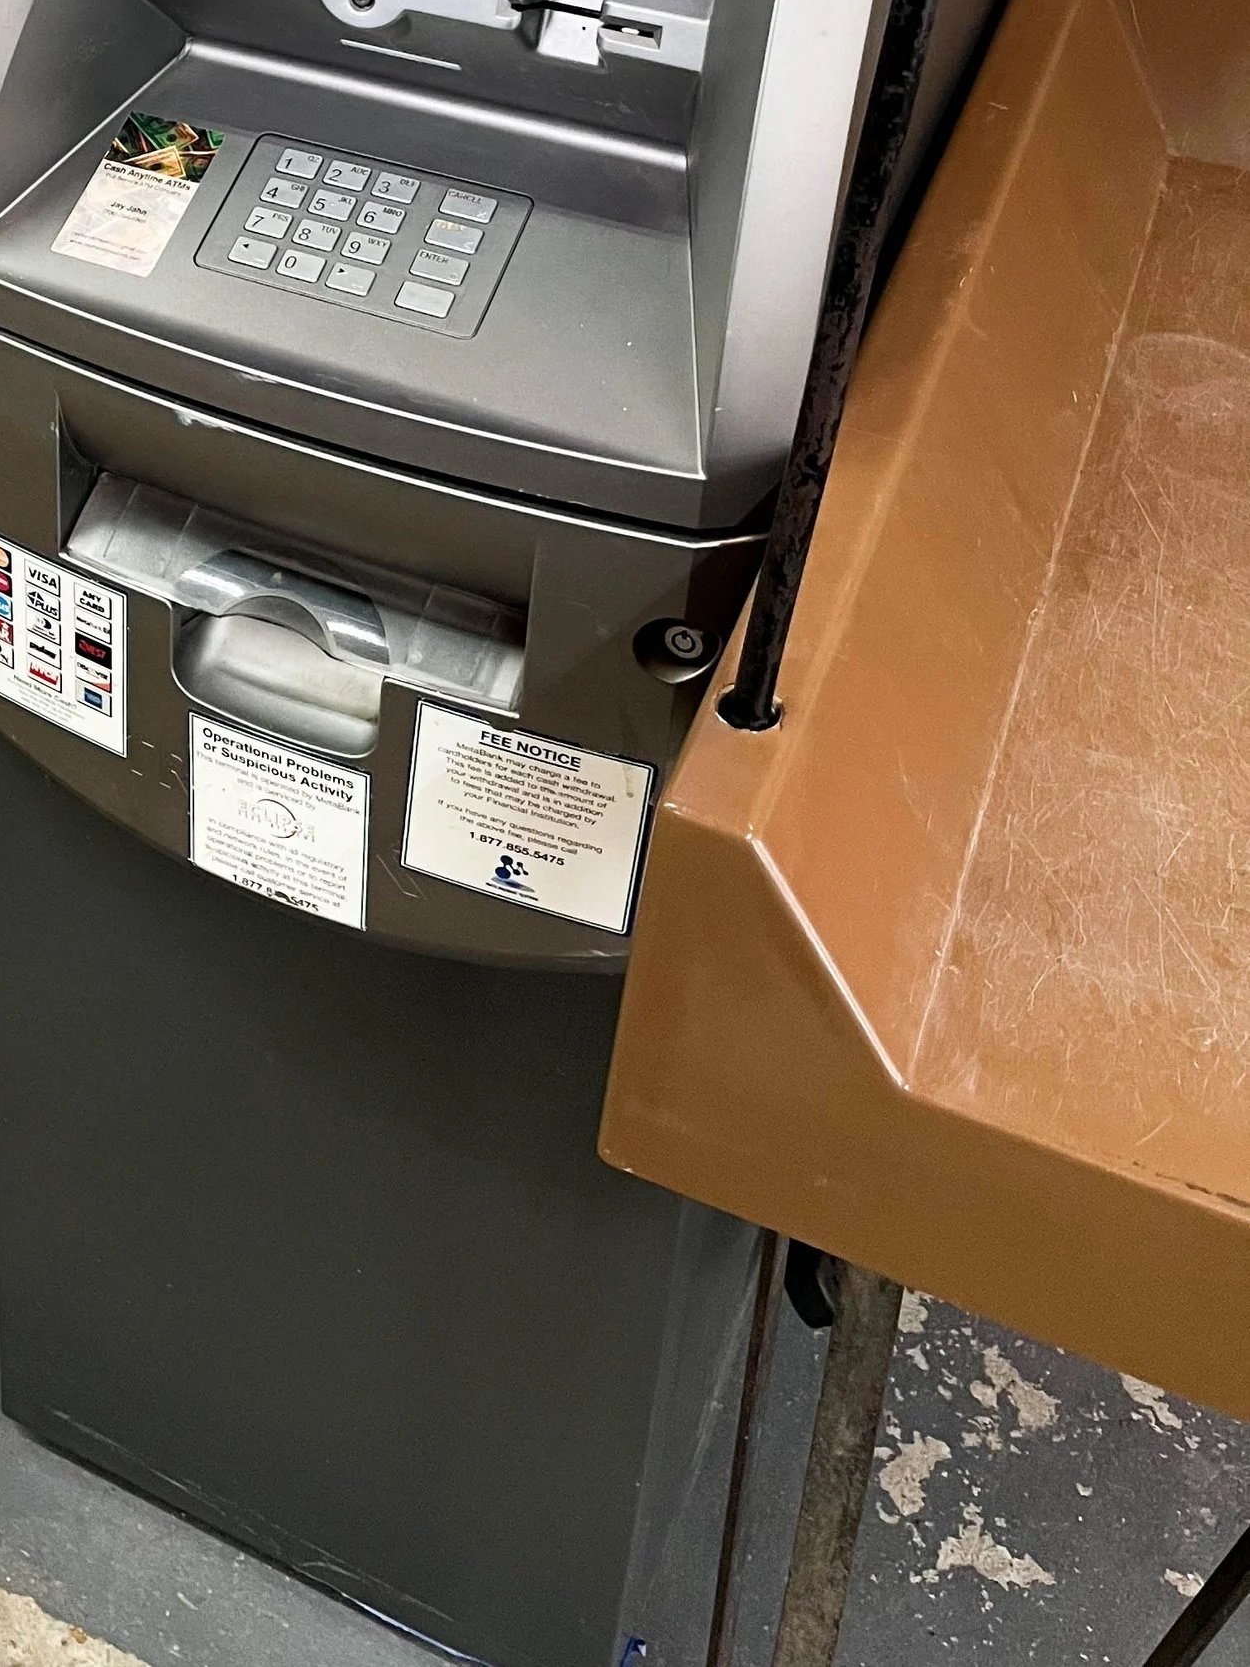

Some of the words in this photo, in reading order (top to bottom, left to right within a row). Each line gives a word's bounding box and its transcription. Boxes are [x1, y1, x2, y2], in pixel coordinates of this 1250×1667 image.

[285, 157, 293, 169] 1
[104, 162, 126, 176] Cash
[128, 169, 163, 185] Anytime
[166, 179, 191, 191] ATMs
[328, 168, 342, 182] 2
[266, 187, 279, 199] 4
[378, 181, 391, 193] 3
[313, 198, 327, 211] 5
[254, 215, 264, 227] 7
[363, 211, 377, 224] 6
[298, 228, 311, 241] 8
[349, 241, 361, 254] 9
[284, 256, 297, 269] 0
[419, 251, 448, 264] ENTER
[27, 567, 57, 589] VISA
[82, 590, 102, 603] ANY
[36, 600, 58, 617] PLUS
[79, 597, 105, 613] CARD
[480, 730, 512, 748] FEE
[516, 740, 581, 768] NOTICE
[203, 727, 282, 764] Operational
[286, 758, 354, 789] Problems
[203, 742, 217, 753] or
[221, 747, 296, 783] Suspicious
[300, 776, 353, 802] Activity
[456, 742, 503, 762] MetaBank
[505, 758, 526, 769] may
[528, 765, 561, 778] charge
[573, 776, 588, 785] fee
[590, 781, 601, 789] to
[470, 831, 565, 866] 1.877.855.5475
